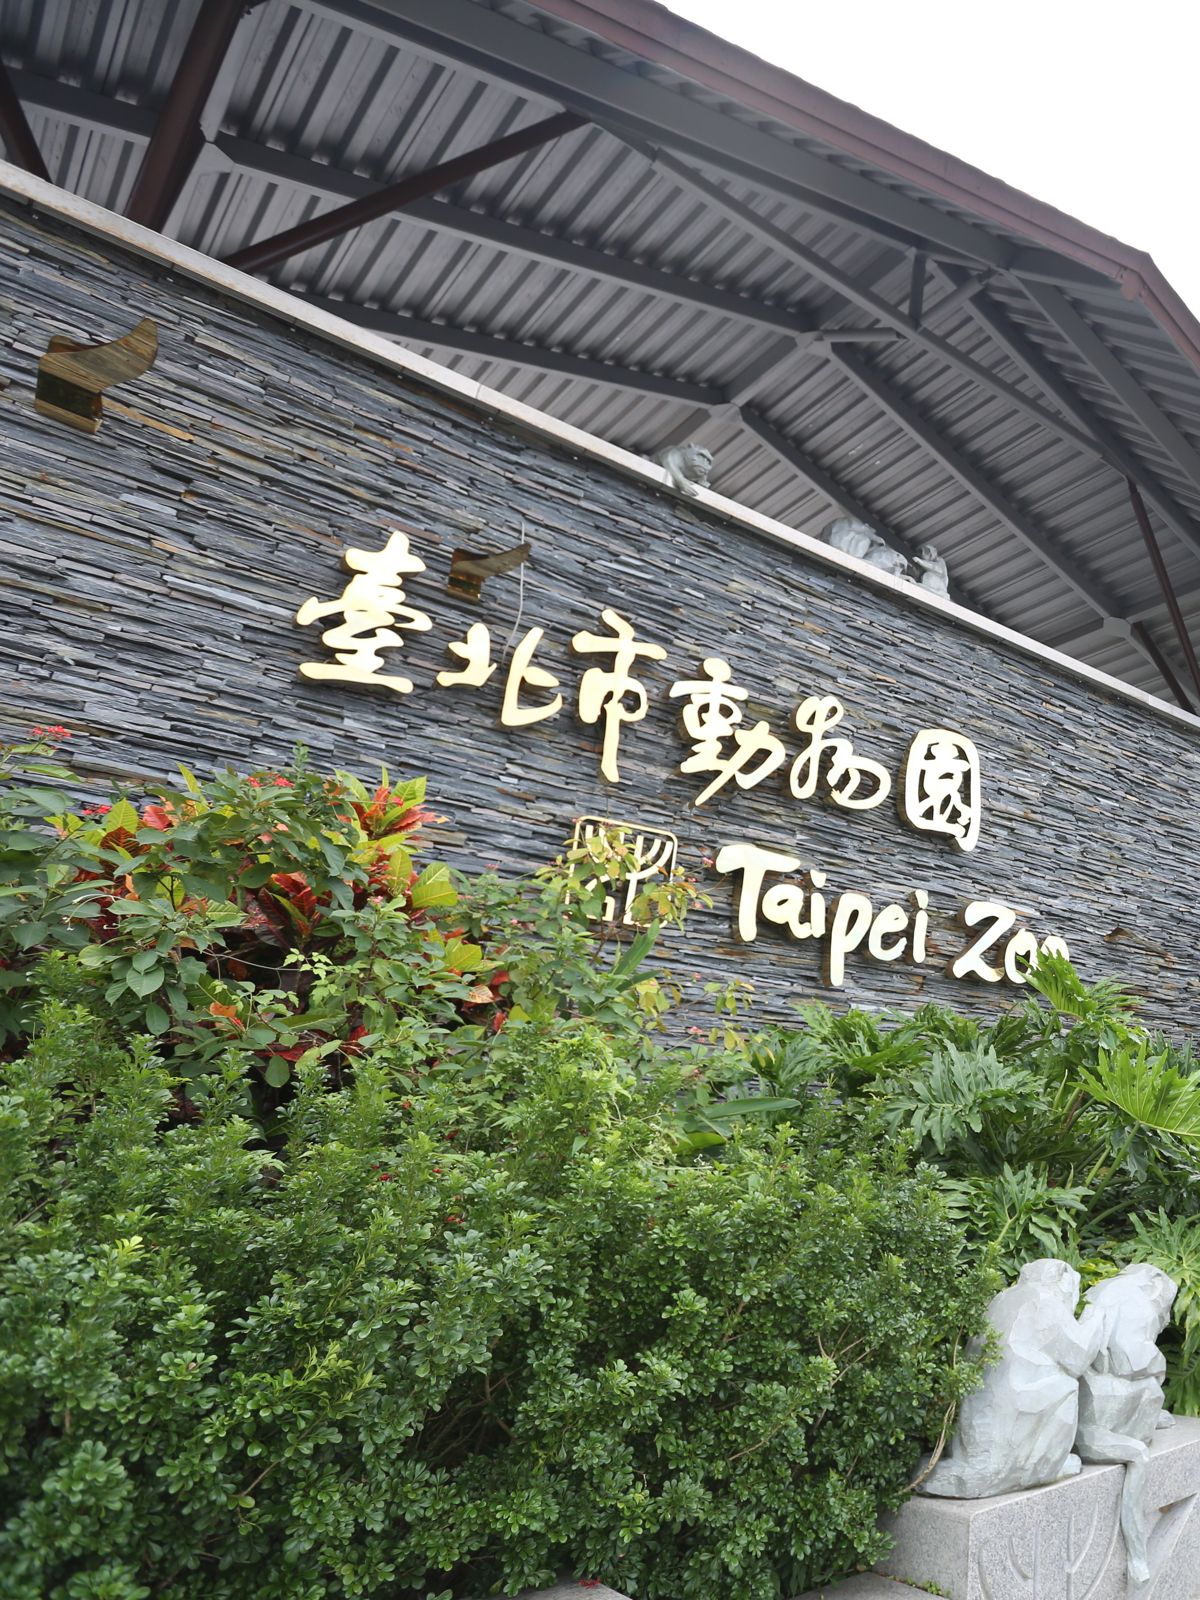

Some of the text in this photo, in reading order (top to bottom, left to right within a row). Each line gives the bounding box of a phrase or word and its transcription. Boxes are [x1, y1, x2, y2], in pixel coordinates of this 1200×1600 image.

[295, 530, 982, 852] 臺北市動物園
[715, 843, 929, 987] Taipei
